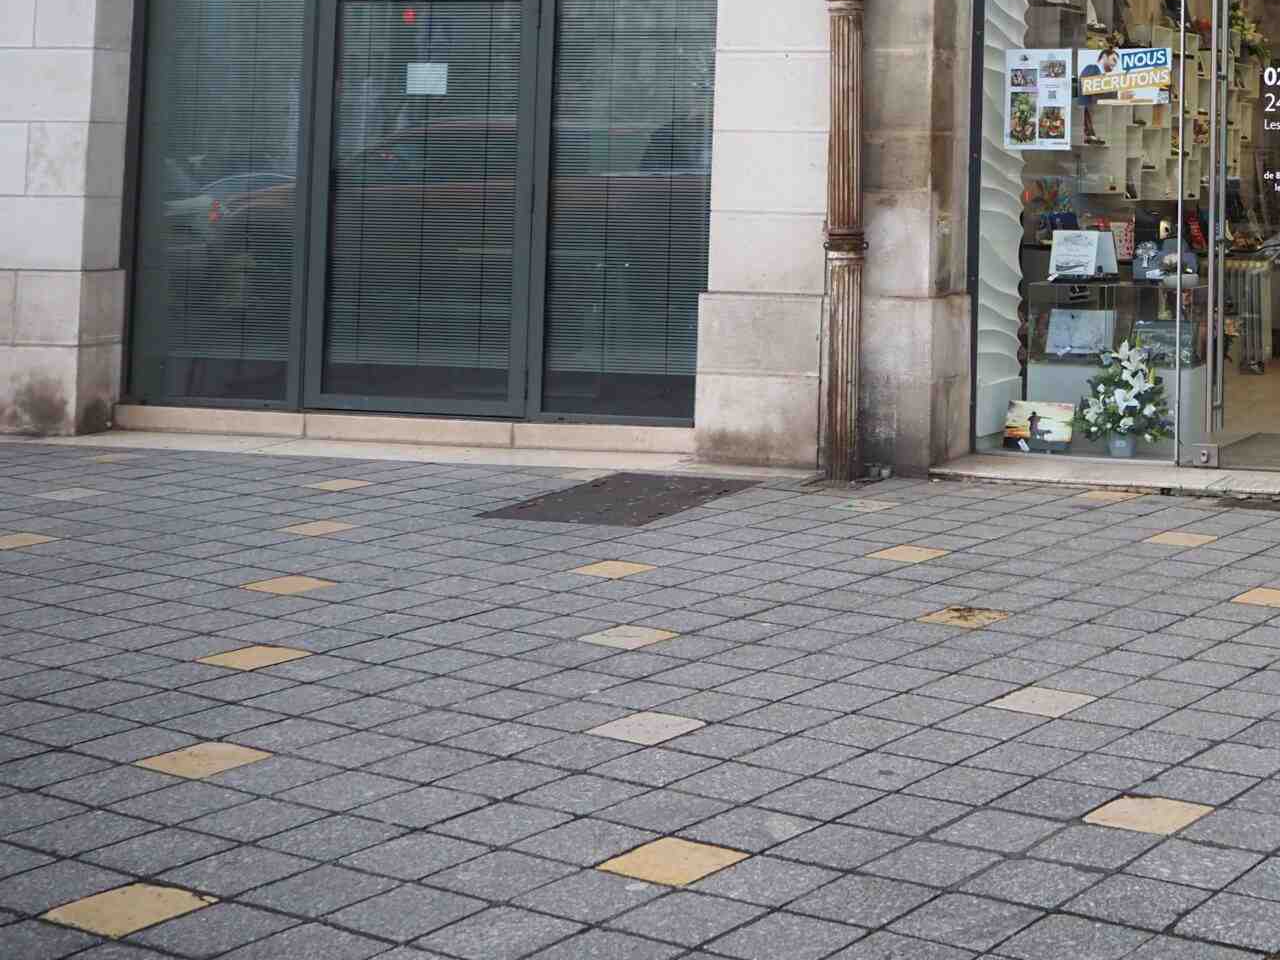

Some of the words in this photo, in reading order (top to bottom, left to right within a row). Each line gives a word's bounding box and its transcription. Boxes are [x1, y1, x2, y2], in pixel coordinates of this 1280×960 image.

[1122, 49, 1167, 69] NOUS
[1082, 70, 1170, 93] RECRUTONS
[1264, 119, 1280, 130] Les
[1264, 172, 1274, 180] de
